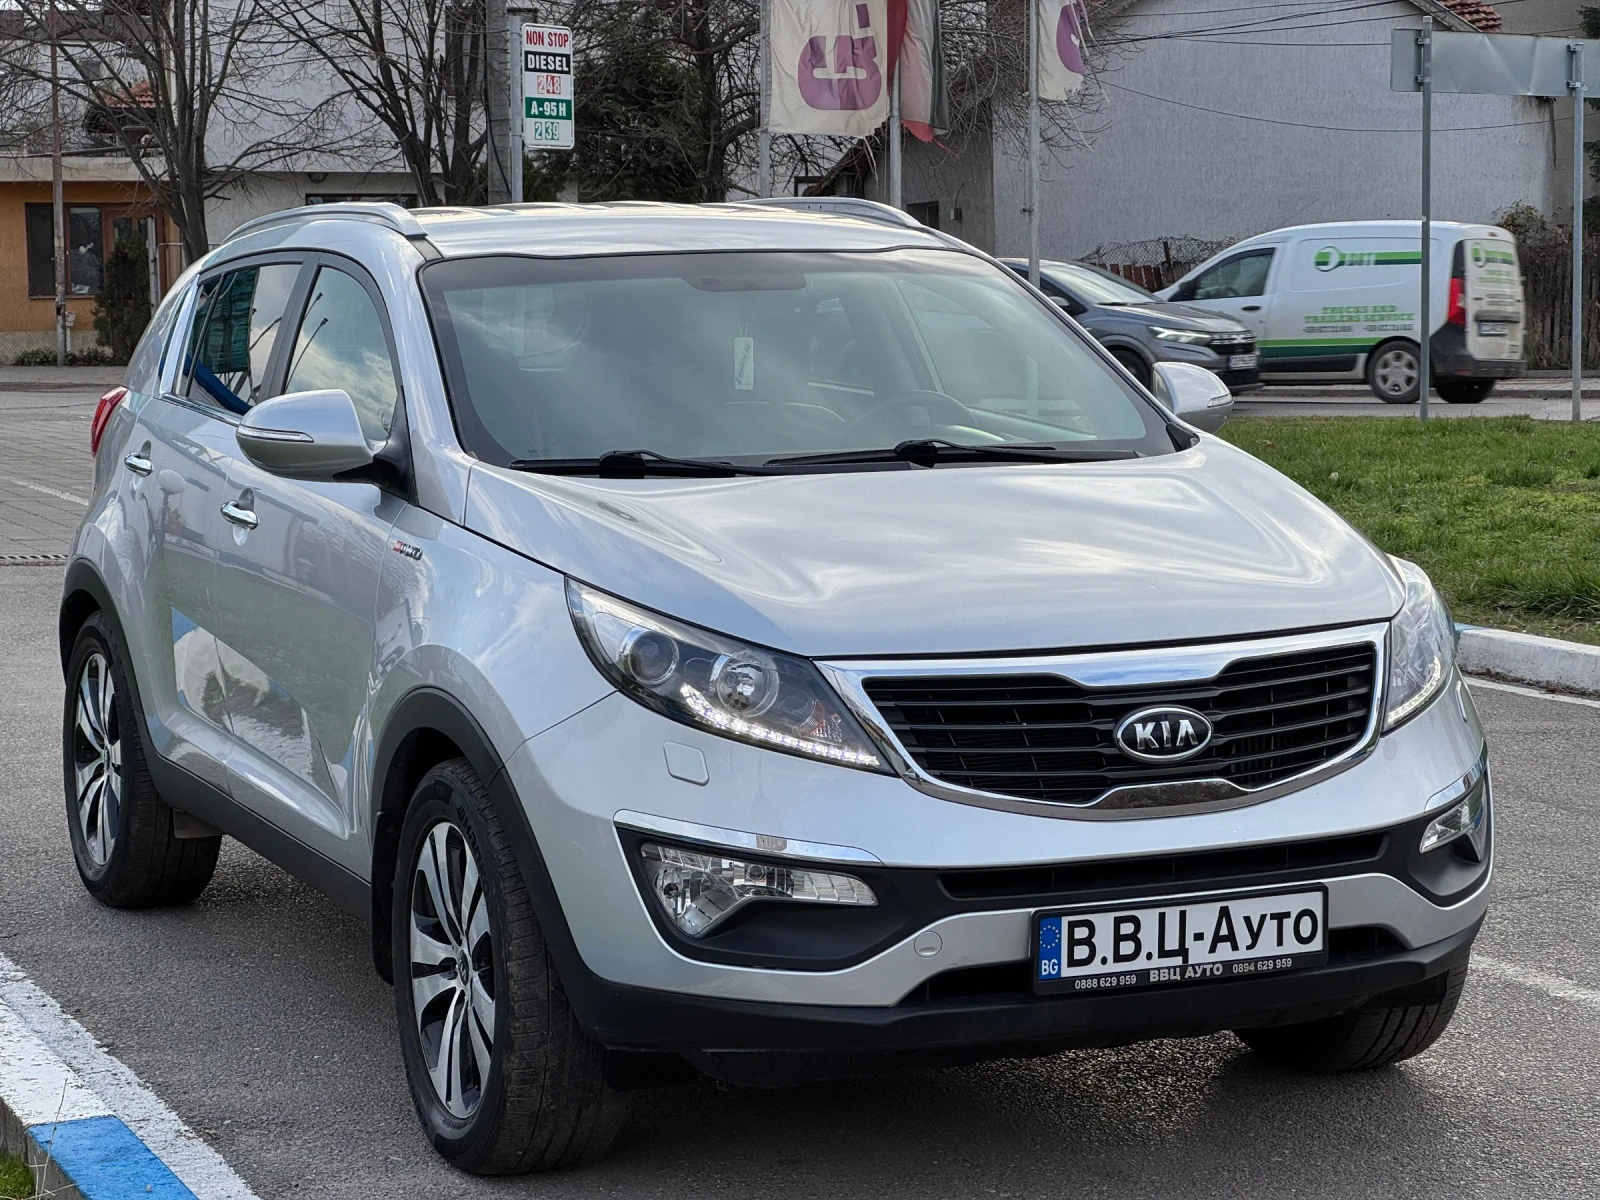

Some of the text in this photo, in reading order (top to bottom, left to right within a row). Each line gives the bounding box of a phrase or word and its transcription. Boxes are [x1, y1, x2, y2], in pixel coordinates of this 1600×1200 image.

[526, 30, 568, 48] NON STOP
[527, 54, 569, 71] DIESEL
[1133, 719, 1199, 750] KIA
[1066, 905, 1319, 968] В.В.Ц-Ауто
[1041, 958, 1059, 976] BG
[1149, 963, 1223, 982] ВВЦ АУТО
[1232, 957, 1293, 974] 0894 629 959
[1074, 974, 1137, 990] 0888 629 959
